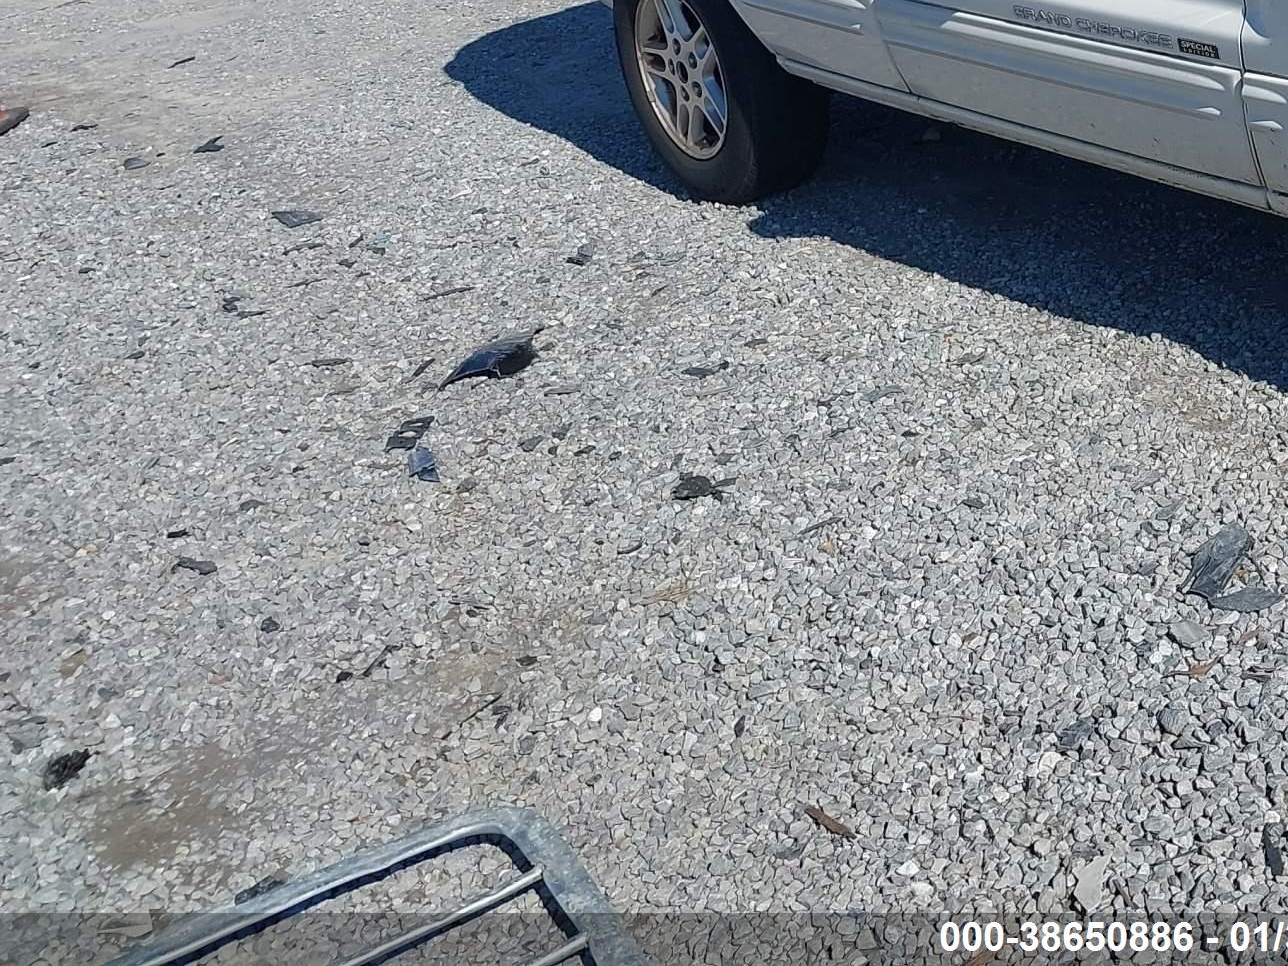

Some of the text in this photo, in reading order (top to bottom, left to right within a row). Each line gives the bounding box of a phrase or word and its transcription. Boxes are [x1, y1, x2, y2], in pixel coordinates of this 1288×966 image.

[1012, 4, 1174, 50] GRAND CHEROKEE
[1180, 39, 1217, 54] SPECIAL
[1183, 47, 1217, 58] EDITION
